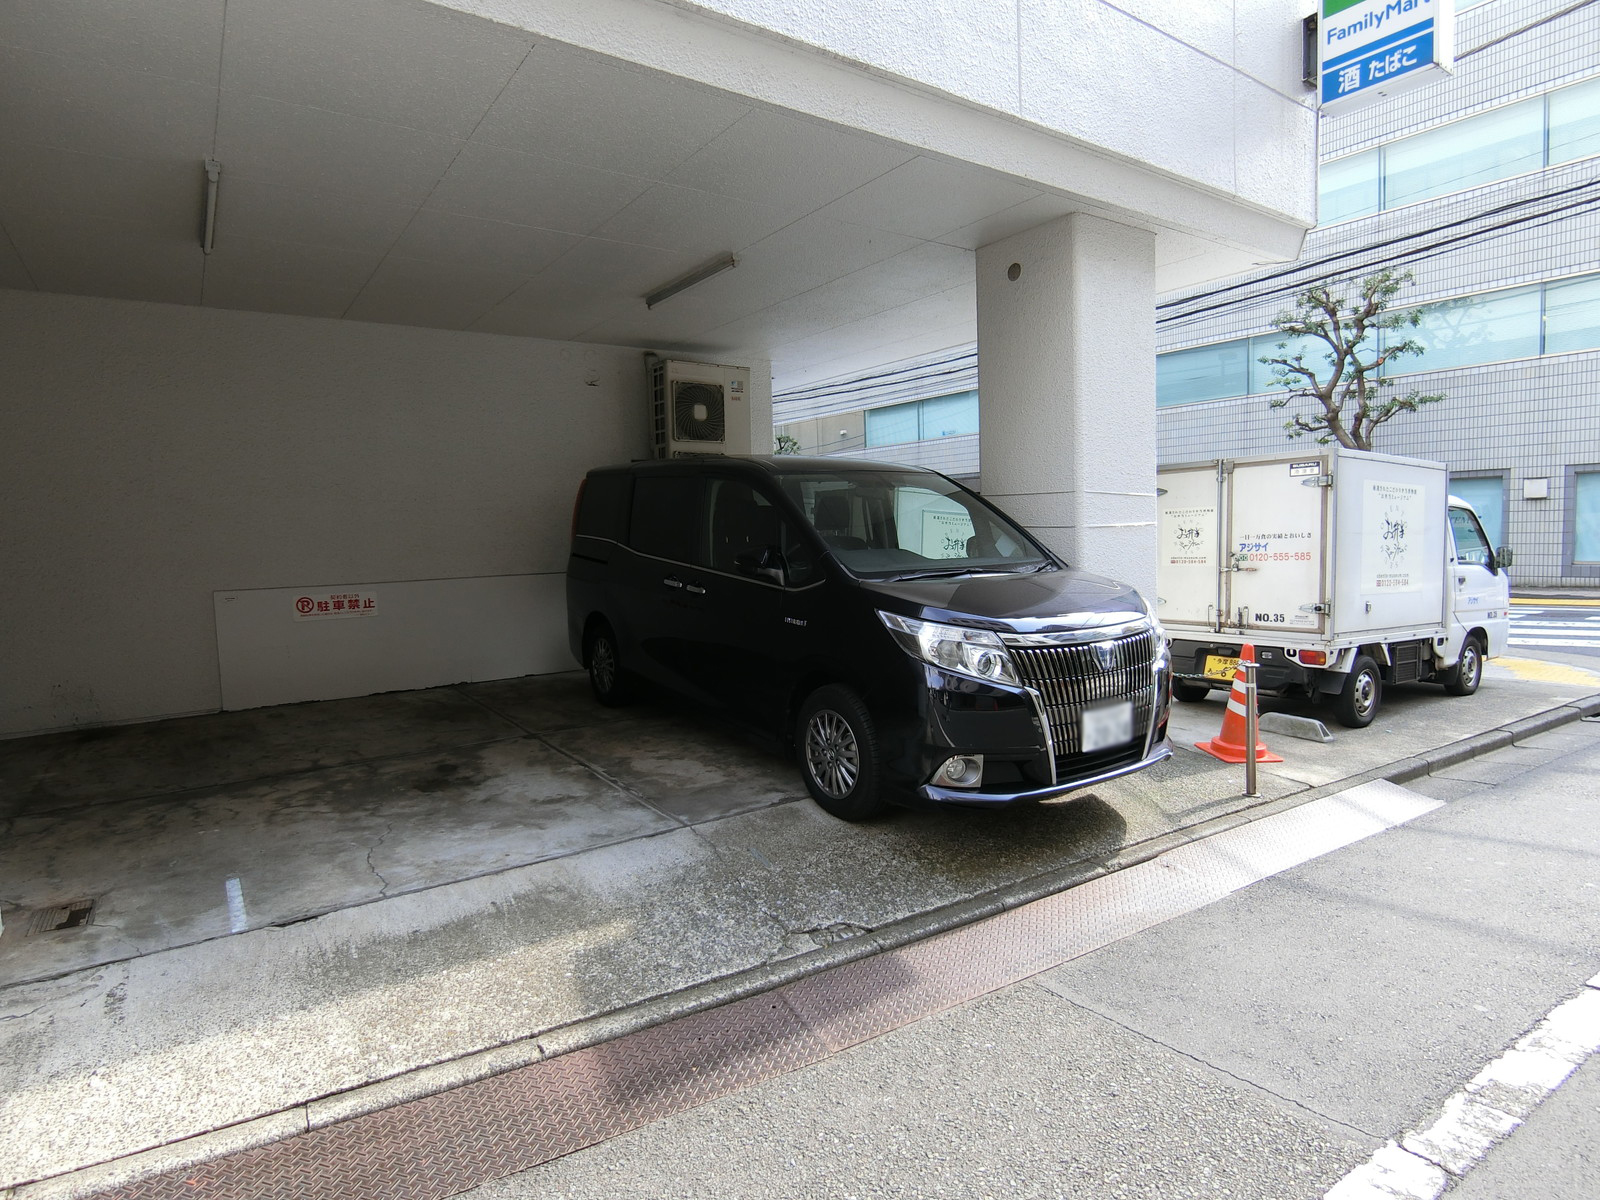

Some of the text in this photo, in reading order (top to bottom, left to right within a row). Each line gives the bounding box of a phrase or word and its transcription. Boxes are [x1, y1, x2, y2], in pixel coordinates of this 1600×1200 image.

[1327, 0, 1431, 45] FamilyMar
[1338, 45, 1418, 94] 酒 たばこ
[1239, 542, 1269, 553] アジサイ
[1249, 552, 1312, 562] 0120-555-585
[317, 597, 376, 613] 駐車禁止
[1255, 613, 1285, 623] NO.35
